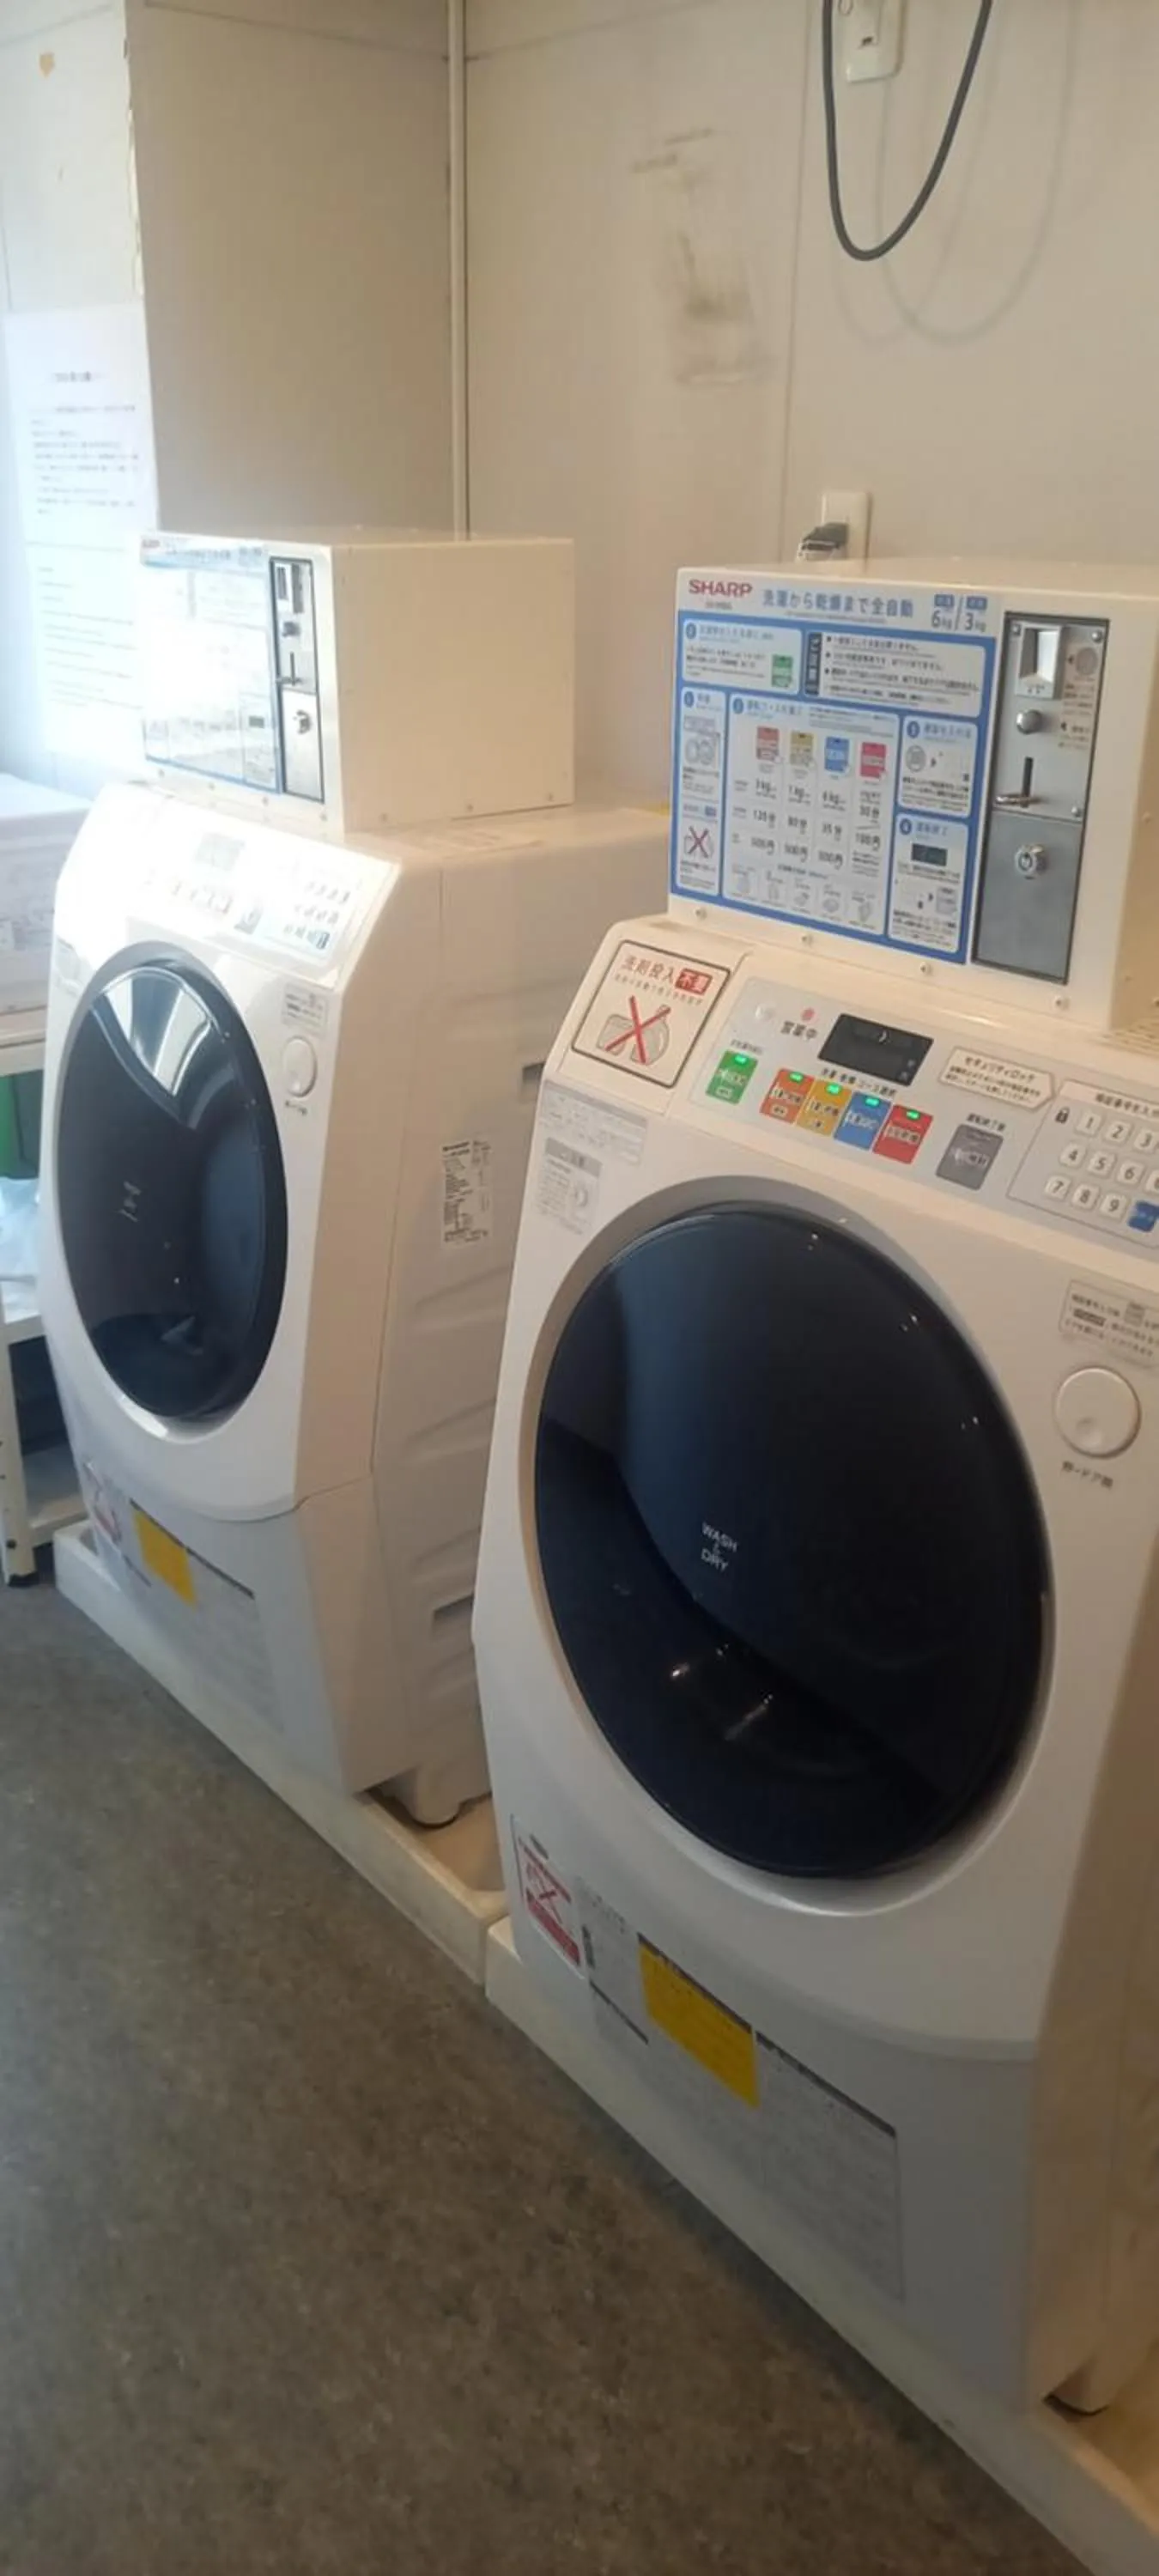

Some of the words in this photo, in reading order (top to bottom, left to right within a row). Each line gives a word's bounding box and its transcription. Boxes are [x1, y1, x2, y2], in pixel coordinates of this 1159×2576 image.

[689, 579, 753, 598] SHARP
[1112, 1126, 1124, 1139] 2
[1140, 1133, 1152, 1147] 3
[1068, 1150, 1078, 1162] 4
[1095, 1157, 1106, 1170] 5
[1125, 1166, 1135, 1180] 6
[1053, 1181, 1064, 1194] 7
[1080, 1189, 1090, 1203] 8
[1109, 1199, 1120, 1212] 9
[701, 1522, 738, 1552] WASH
[701, 1547, 729, 1572] DRY
